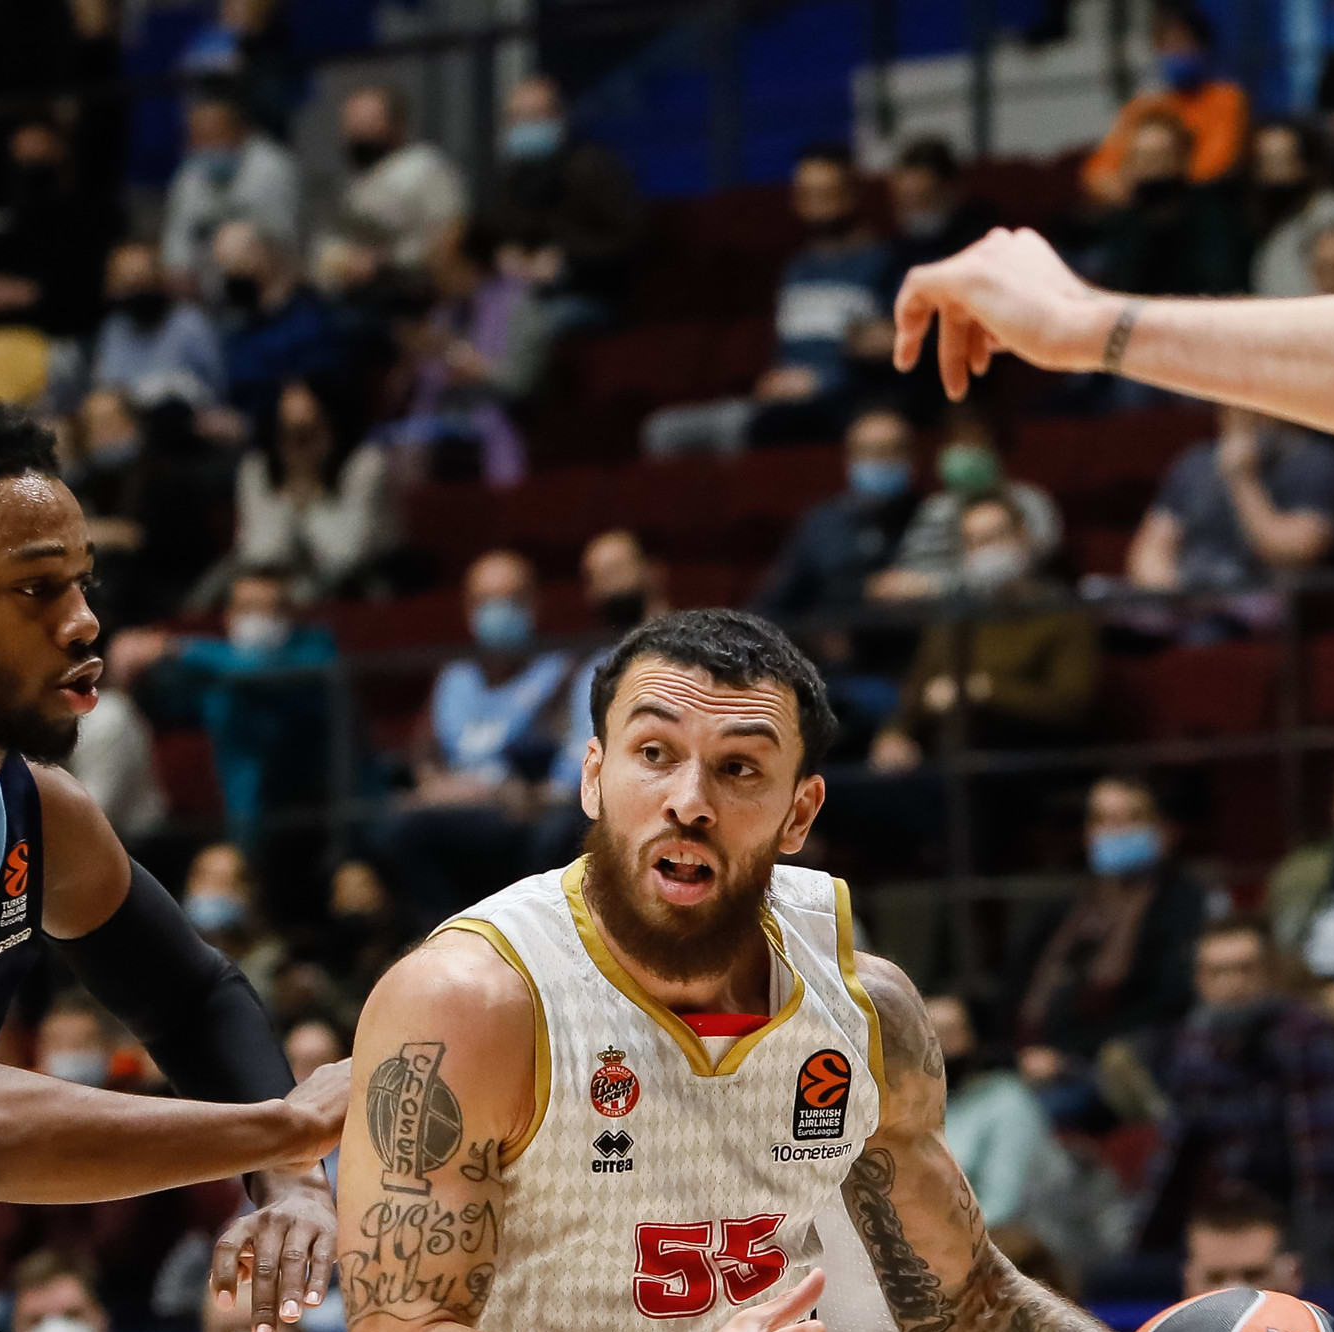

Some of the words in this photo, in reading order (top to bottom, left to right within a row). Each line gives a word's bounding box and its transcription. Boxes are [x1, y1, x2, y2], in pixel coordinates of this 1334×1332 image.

[799, 1108, 842, 1119] TURKISH
[798, 1118, 840, 1128] AIRLINES
[797, 1127, 840, 1137] EuroLeague
[633, 1213, 789, 1320] 55
